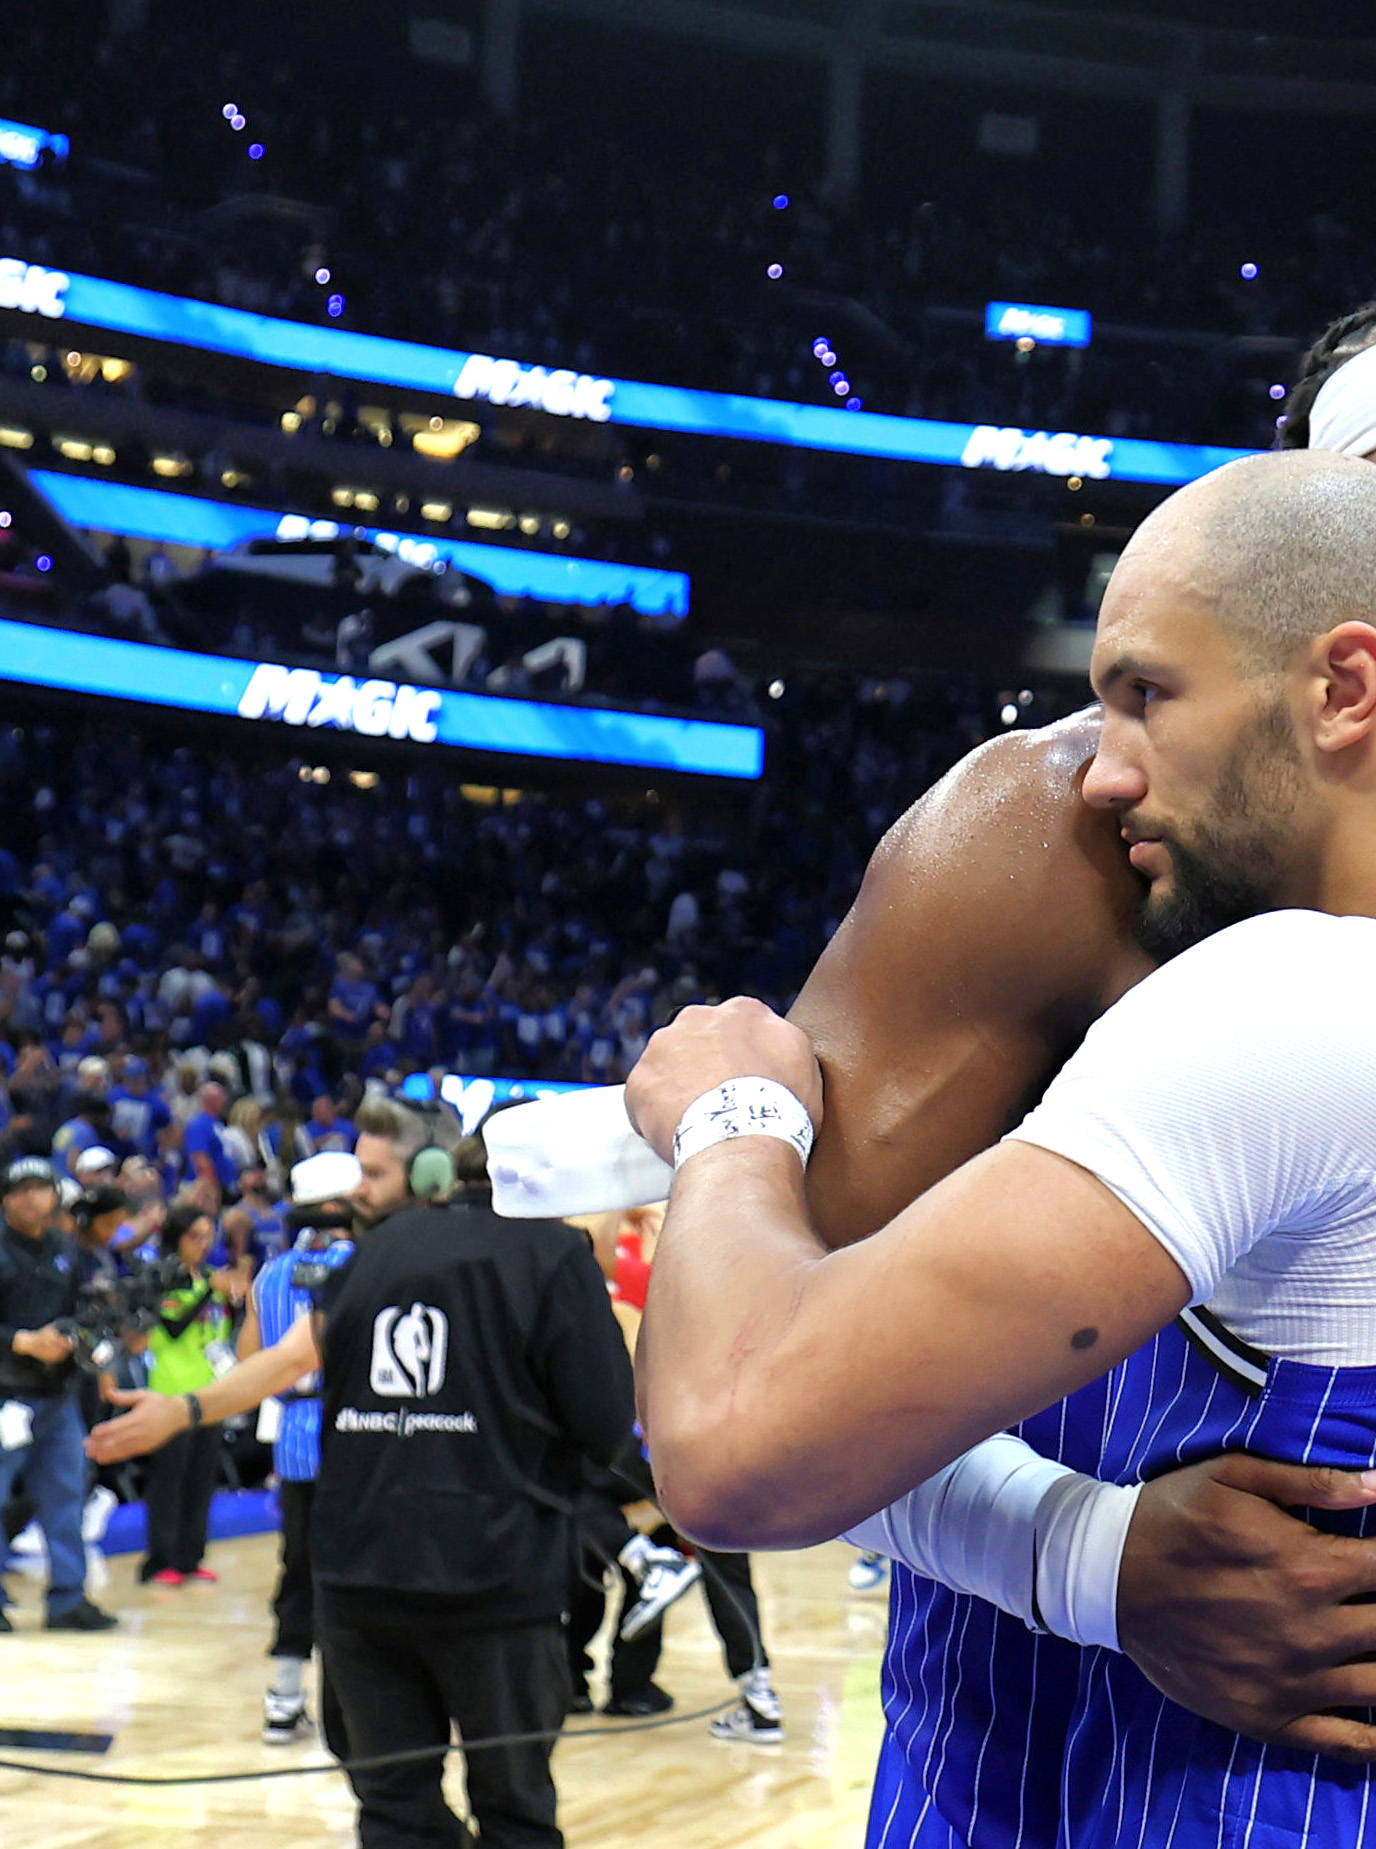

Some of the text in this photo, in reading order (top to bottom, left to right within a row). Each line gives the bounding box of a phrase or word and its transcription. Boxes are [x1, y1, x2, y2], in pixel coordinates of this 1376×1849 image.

[0, 257, 70, 319] GIC
[454, 354, 615, 423] MAGIC
[961, 425, 1113, 479] MAGIC
[237, 663, 442, 743] MAGIC
